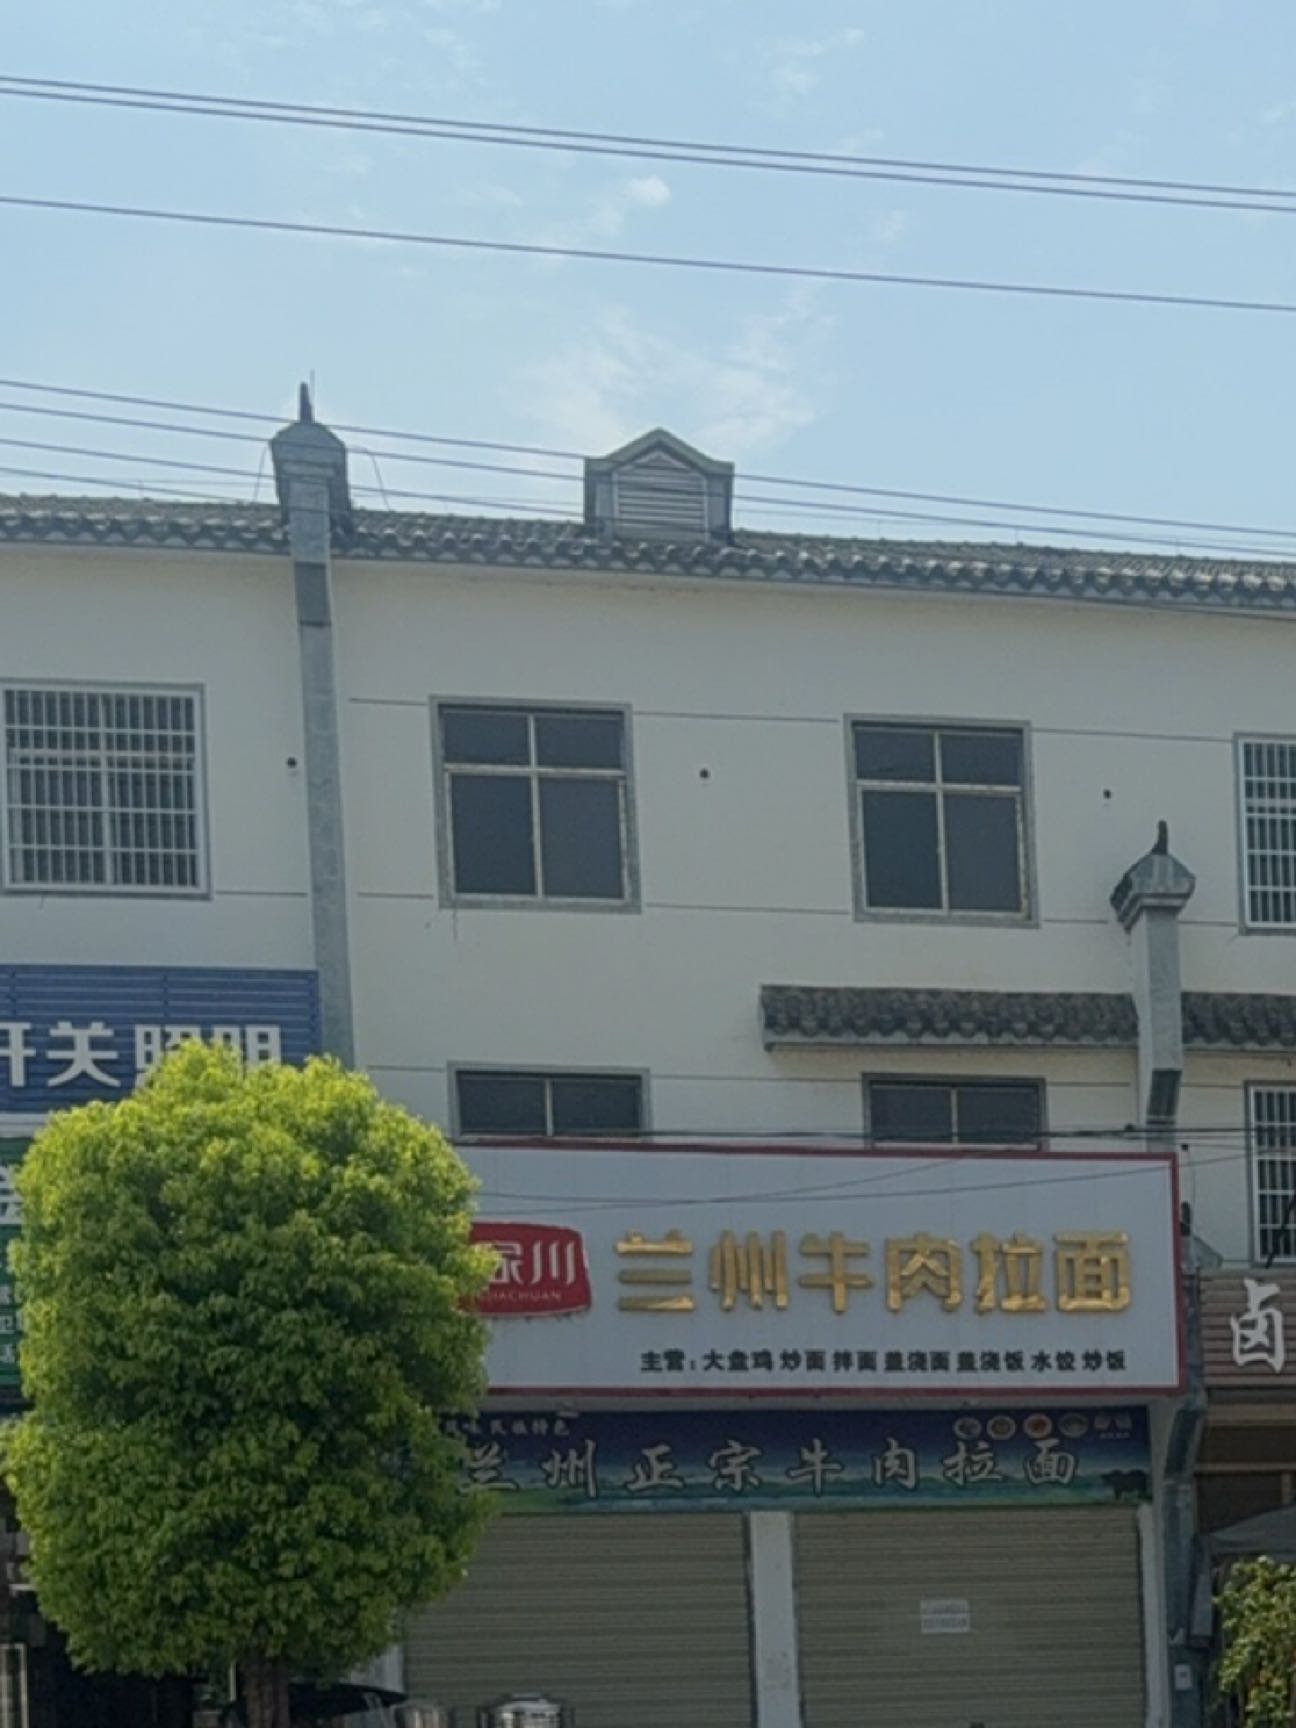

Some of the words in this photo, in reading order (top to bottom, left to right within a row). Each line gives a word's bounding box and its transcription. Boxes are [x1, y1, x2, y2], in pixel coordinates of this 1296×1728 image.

[614, 1228, 1133, 1314] 兰州牛肉拉面
[462, 1438, 1080, 1497] 兰州正宗牛肉拉面
